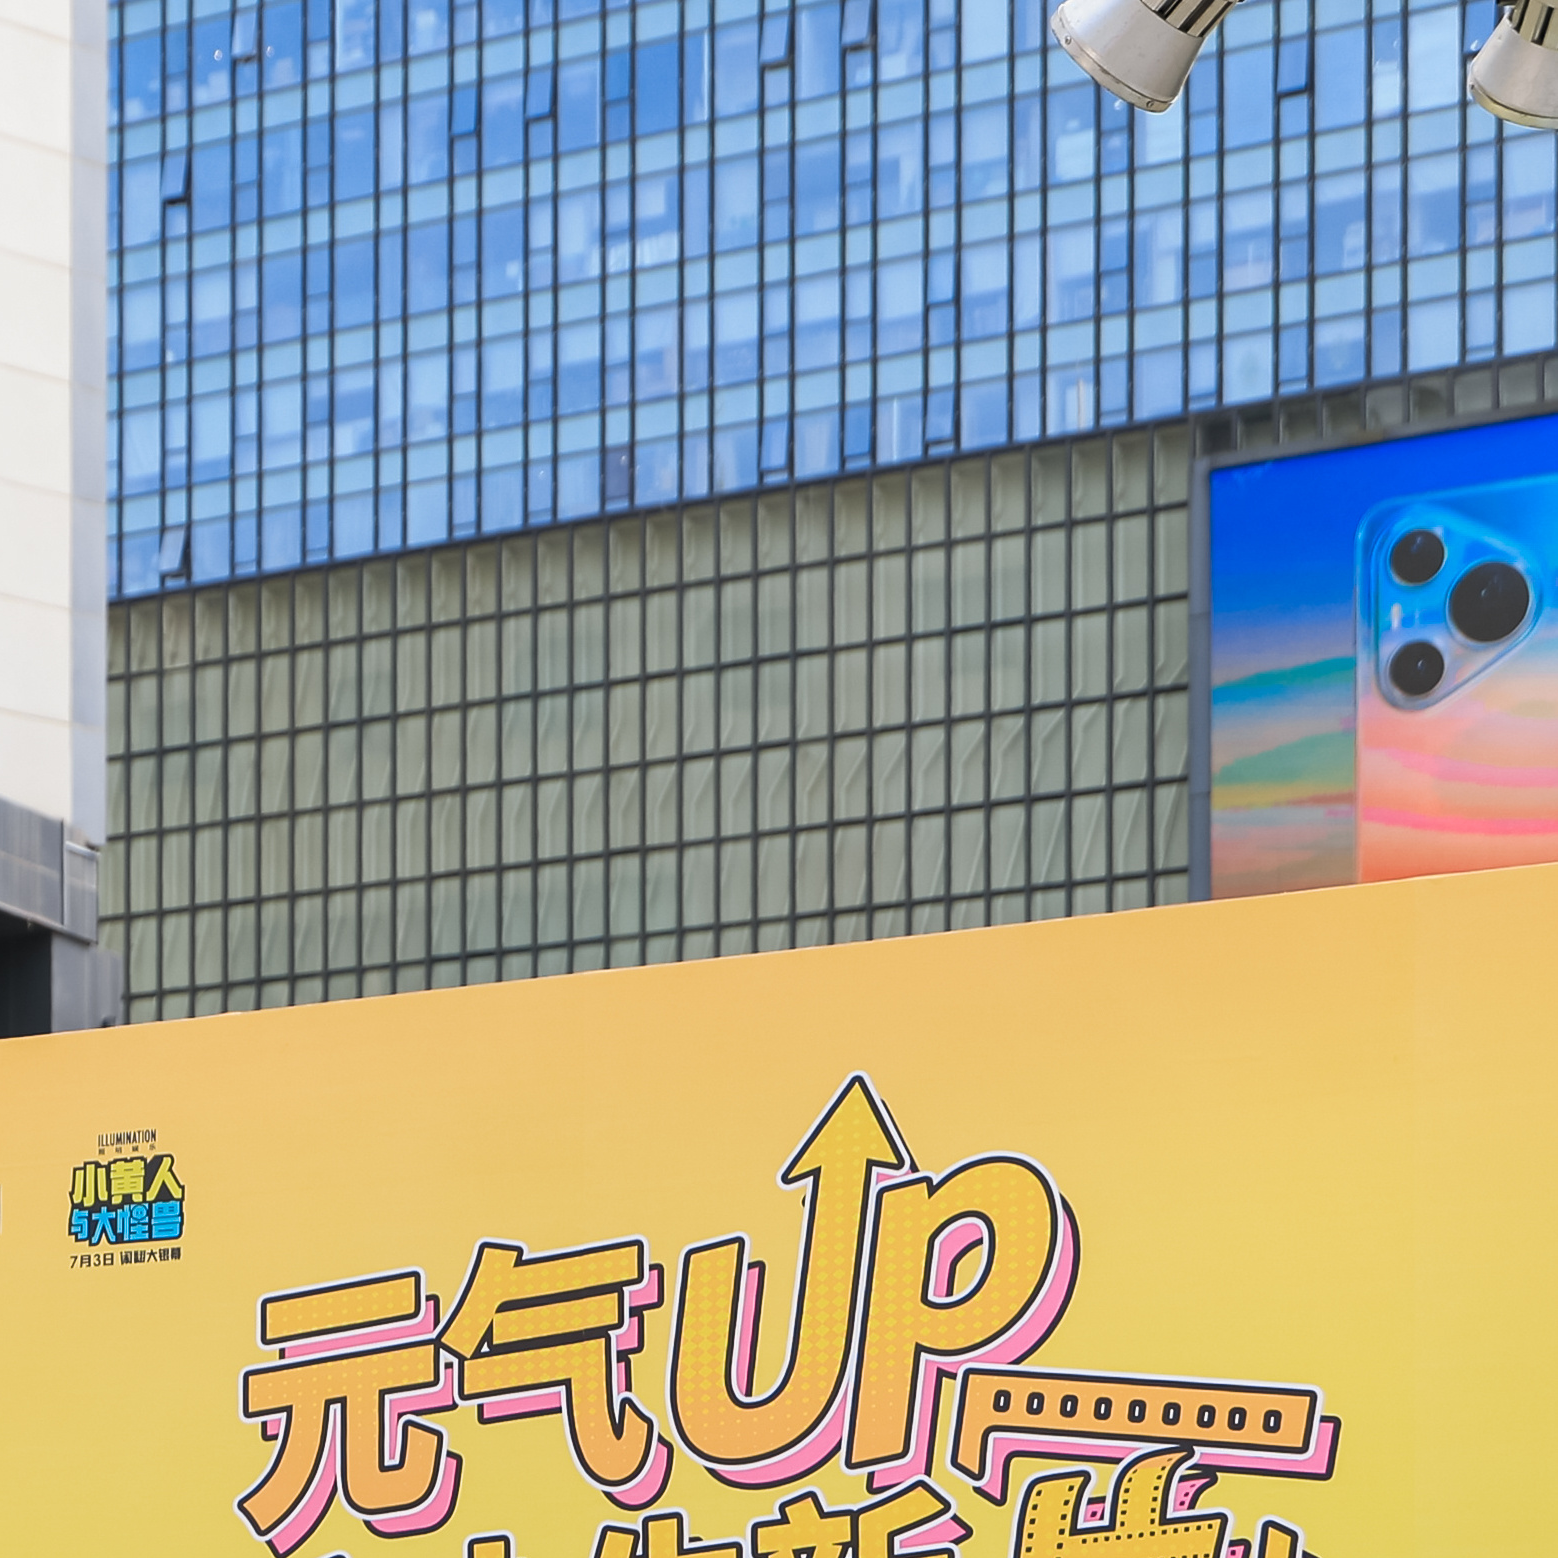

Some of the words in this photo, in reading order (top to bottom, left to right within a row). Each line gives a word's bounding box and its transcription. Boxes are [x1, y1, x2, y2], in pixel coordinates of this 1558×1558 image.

[98, 1129, 157, 1147] ILLUMINATION
[69, 1155, 184, 1207] 小黄人
[68, 1200, 184, 1246] 与大怪兽
[70, 1253, 114, 1268] 7月3日
